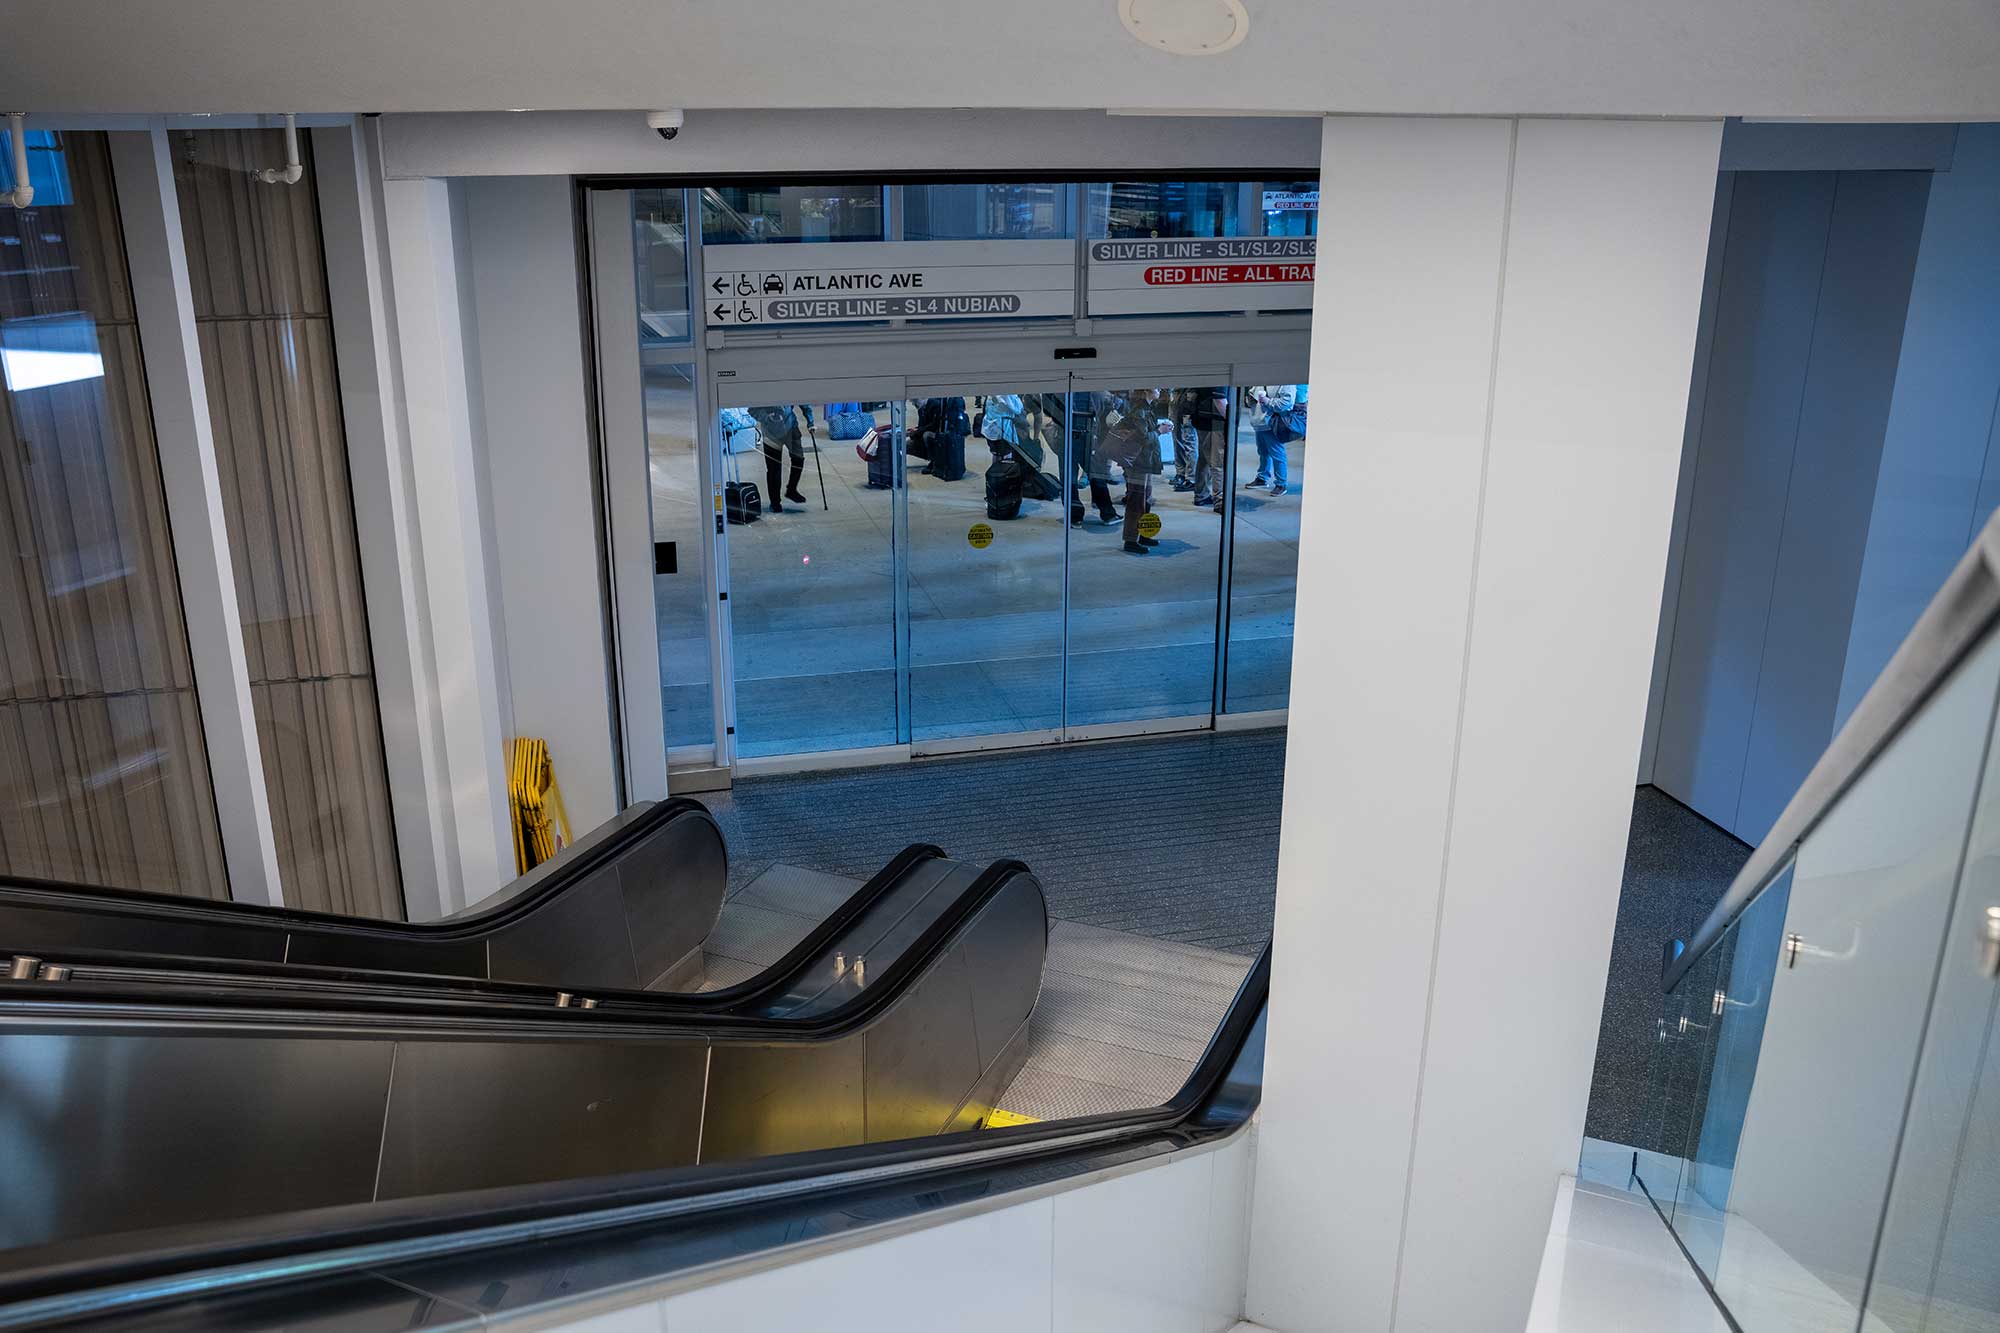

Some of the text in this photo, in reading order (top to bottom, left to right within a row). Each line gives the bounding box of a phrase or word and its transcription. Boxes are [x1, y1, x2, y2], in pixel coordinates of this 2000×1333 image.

[1100, 244, 1158, 260] SILVER
[1164, 243, 1201, 258] LINE
[1217, 241, 1317, 257] SL1/SL2/SL3
[793, 273, 923, 290] ATLANTIC AVE
[1151, 268, 1186, 283] RED
[1191, 267, 1228, 282] LINE
[1244, 267, 1274, 281] ALL
[777, 302, 840, 317] SILVER
[846, 300, 887, 316] LINE
[904, 299, 938, 314] SL4
[944, 297, 1013, 312] NUBIAN
